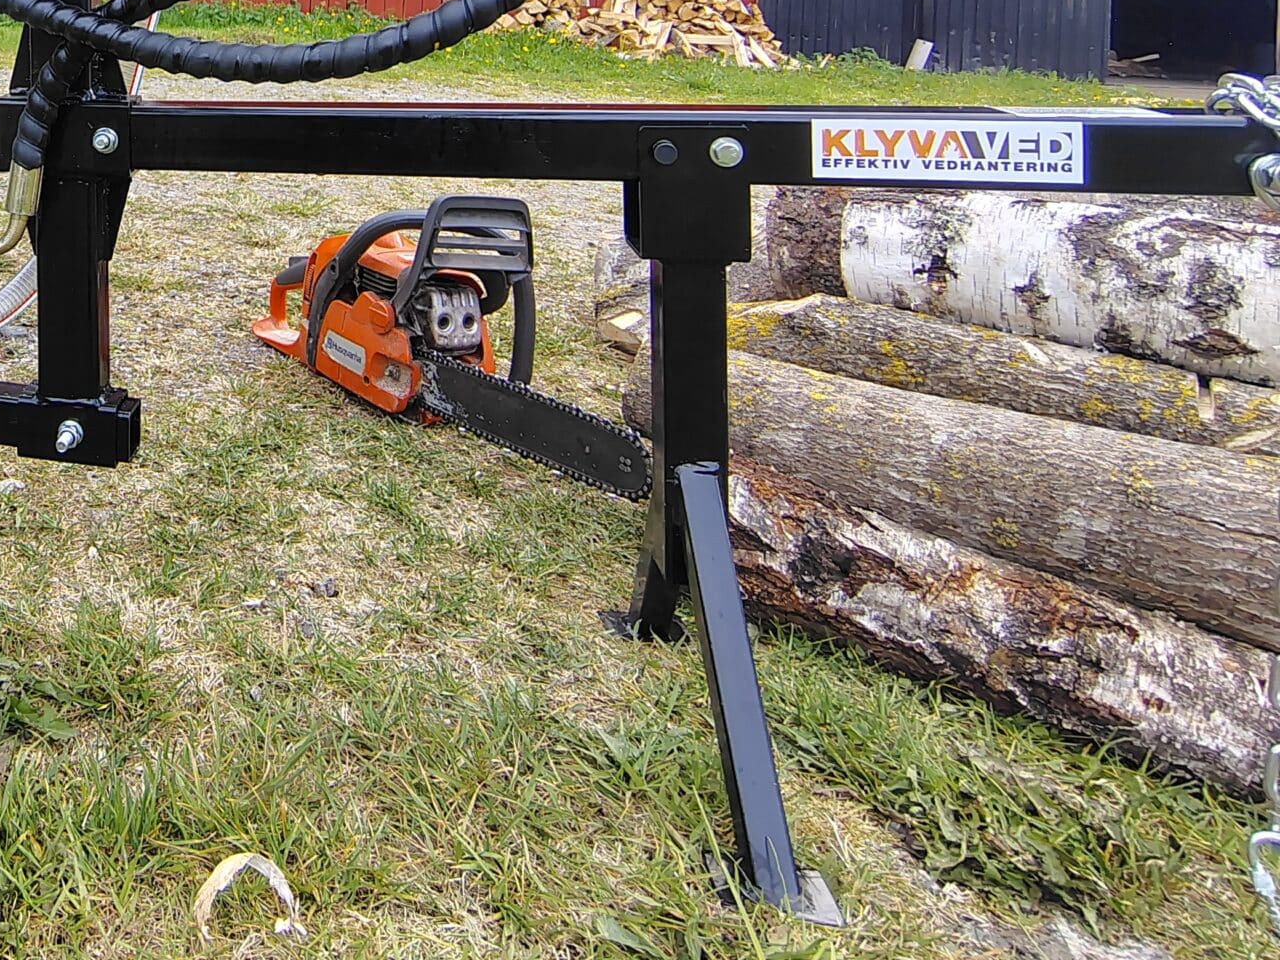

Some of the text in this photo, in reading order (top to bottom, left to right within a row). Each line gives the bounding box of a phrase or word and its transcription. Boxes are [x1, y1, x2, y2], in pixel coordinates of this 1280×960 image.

[822, 128, 1073, 162] KLYVAVED
[821, 157, 1073, 173] EFFEKTIV VEDHANTERING
